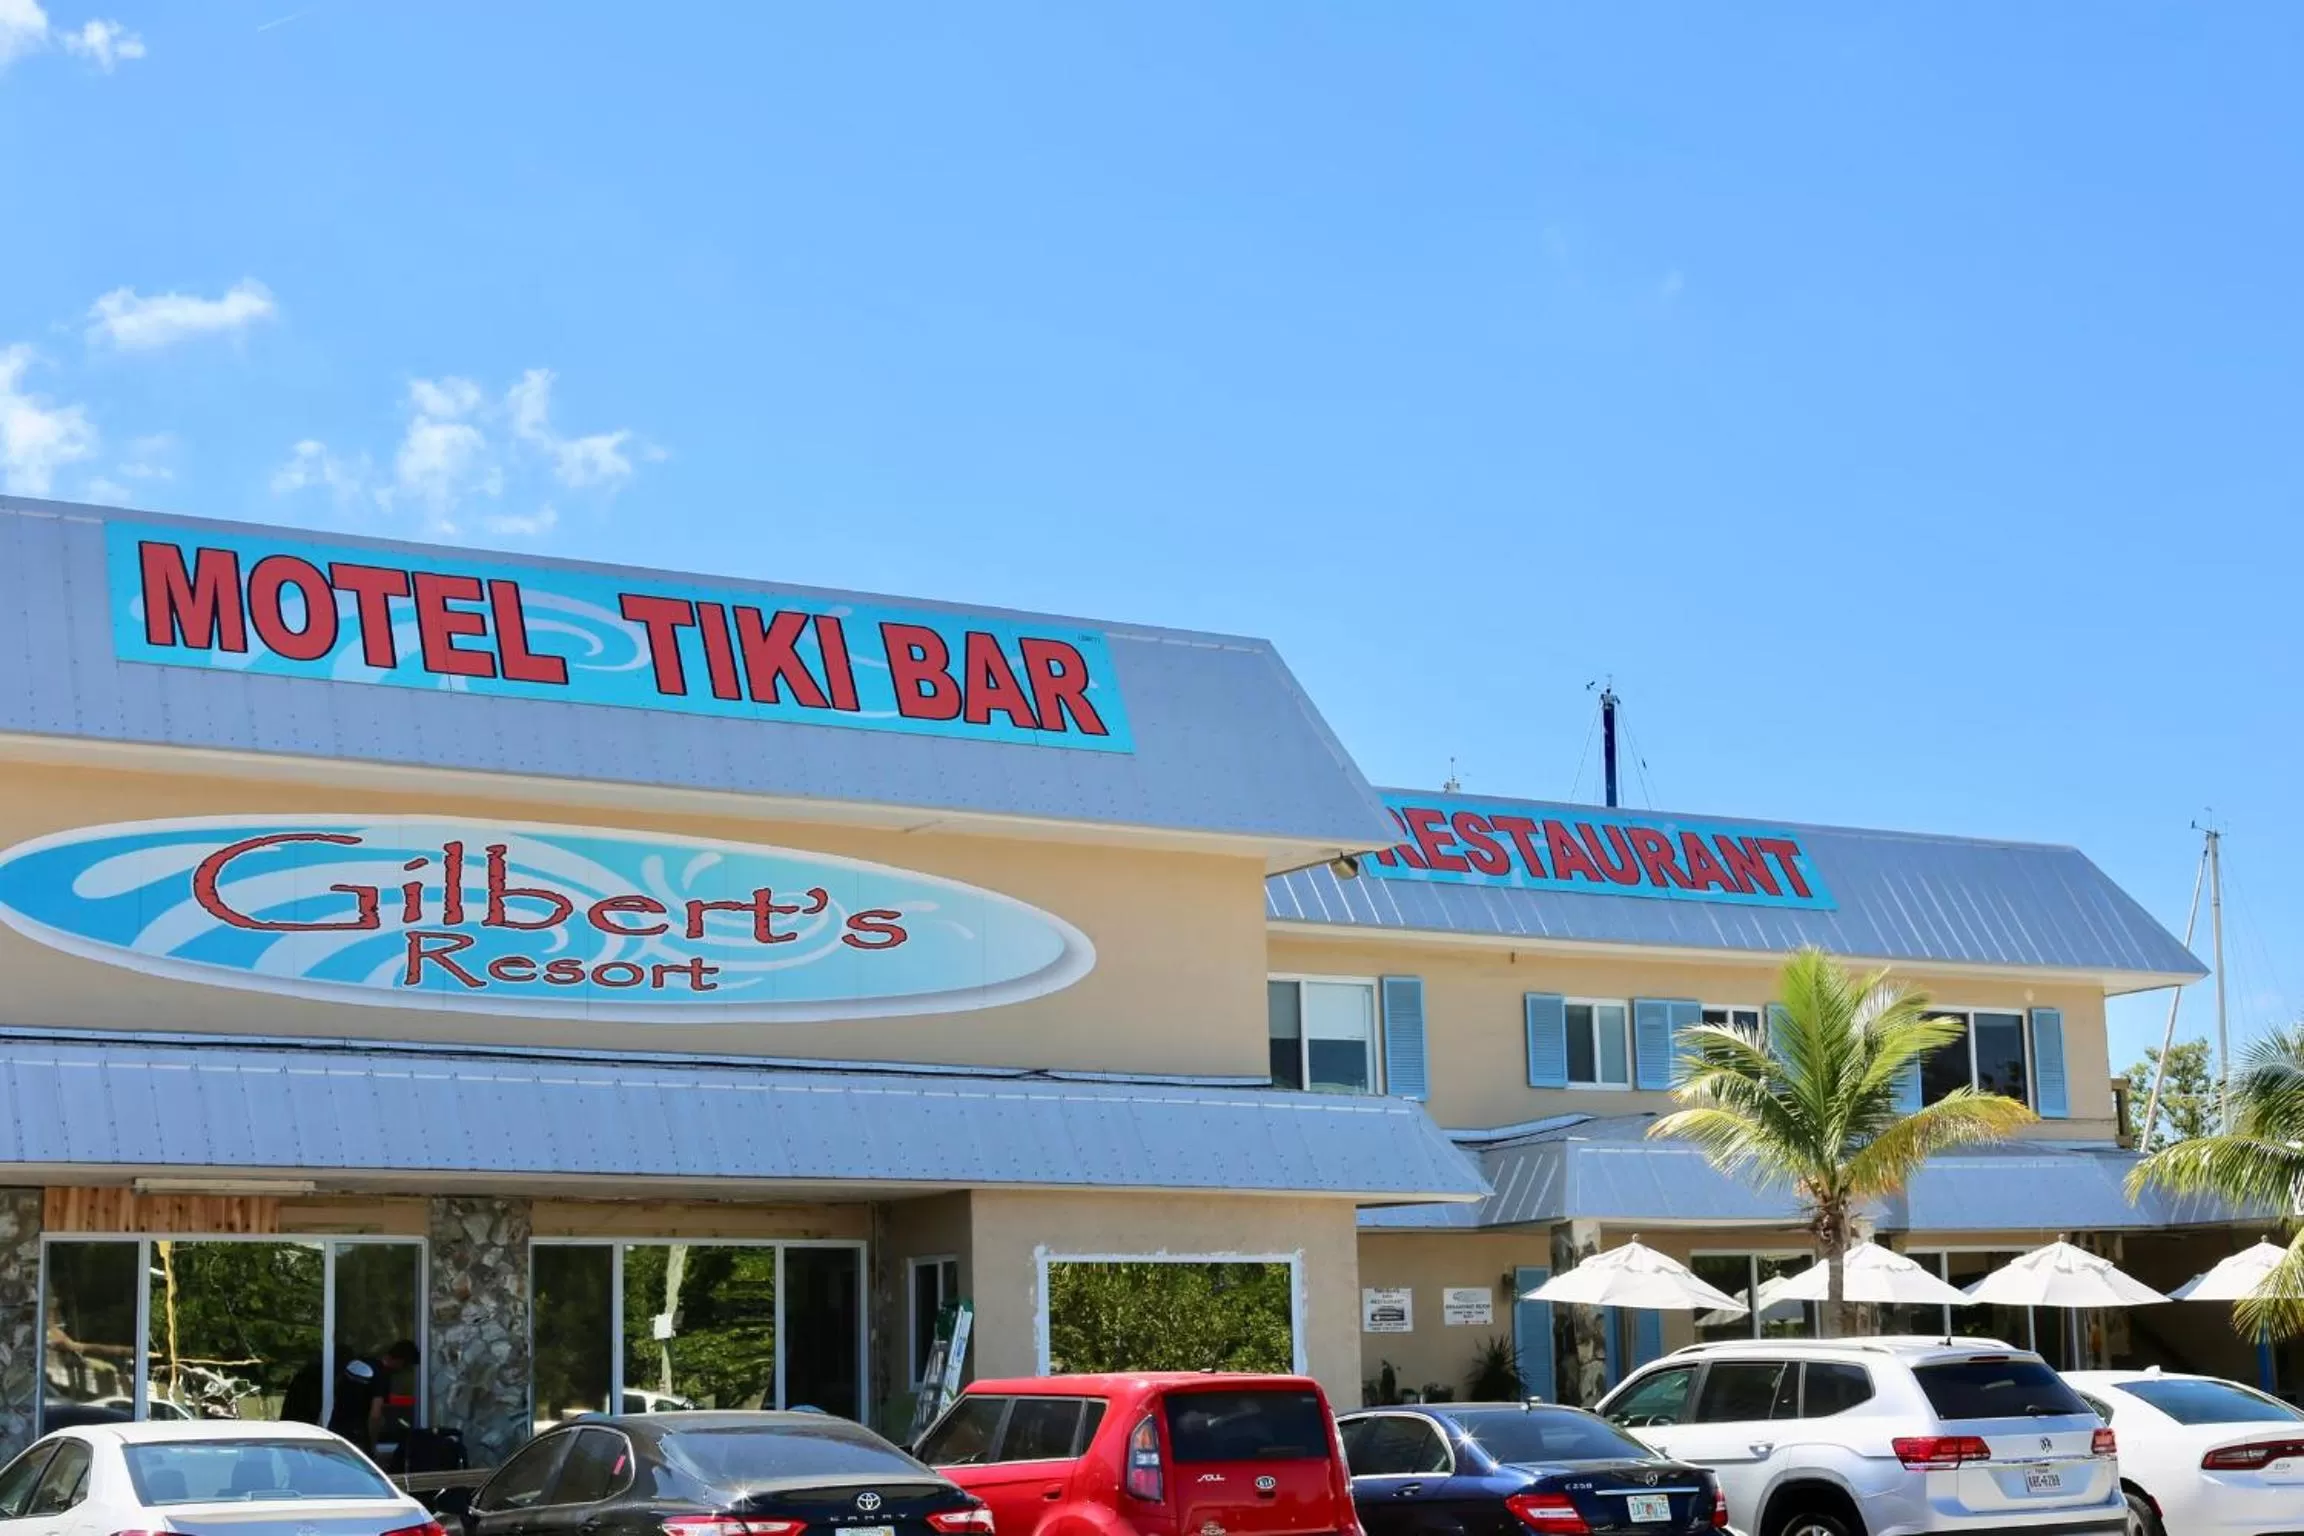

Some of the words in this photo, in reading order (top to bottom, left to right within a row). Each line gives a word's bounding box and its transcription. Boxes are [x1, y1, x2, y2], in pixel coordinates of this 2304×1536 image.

[138, 540, 570, 686] MOTEL
[618, 592, 861, 712] TIKI
[880, 621, 1110, 737] BAR
[192, 831, 910, 952] Gilbert's
[404, 930, 721, 993] Resort
